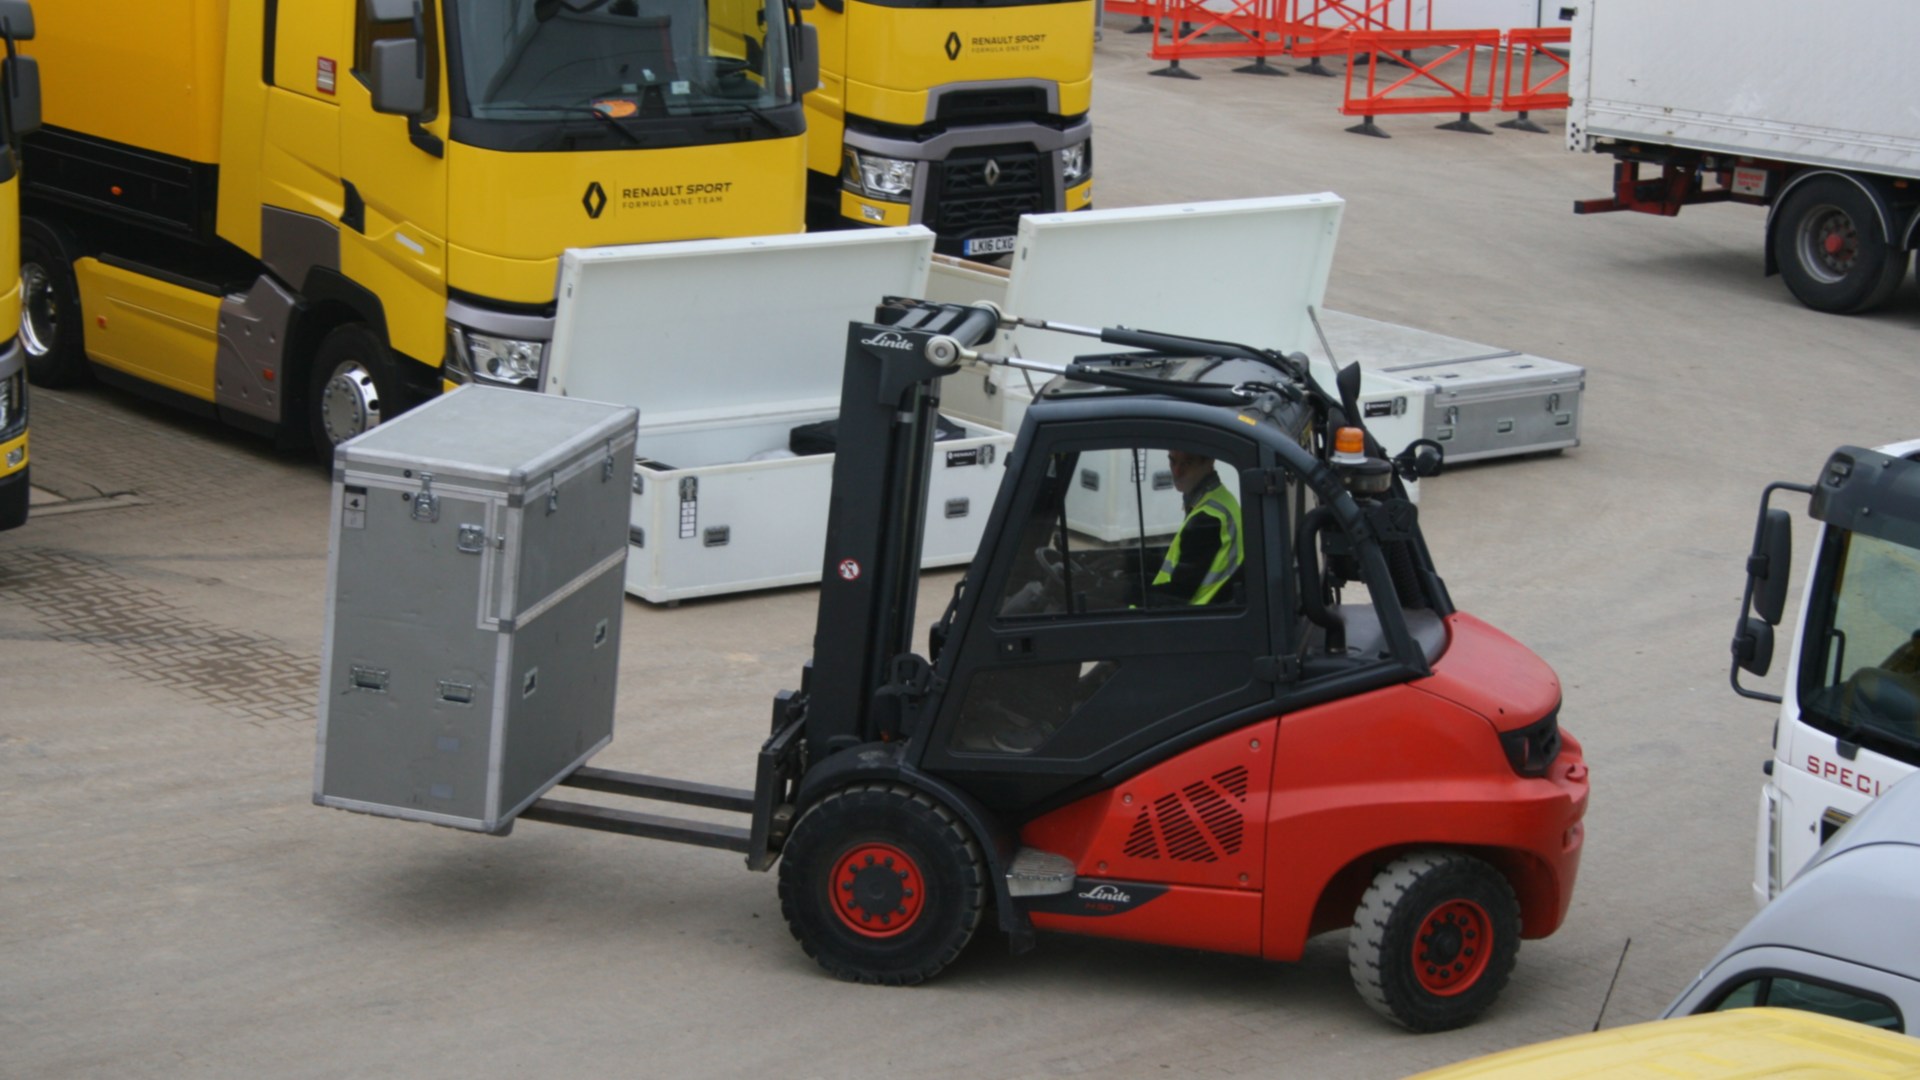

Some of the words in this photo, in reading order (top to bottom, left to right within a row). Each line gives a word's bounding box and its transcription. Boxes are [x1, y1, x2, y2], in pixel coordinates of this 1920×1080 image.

[971, 36, 1013, 46] RENAULT
[1015, 34, 1047, 44] SPORT
[622, 185, 684, 199] RENAULT
[686, 182, 733, 195] SPORT
[622, 200, 669, 209] FORMULA
[673, 197, 693, 206] ONE
[697, 195, 723, 204] TEAM
[861, 331, 914, 351] Linde
[1807, 754, 1882, 798] SPECI
[1078, 885, 1131, 903] Linde
